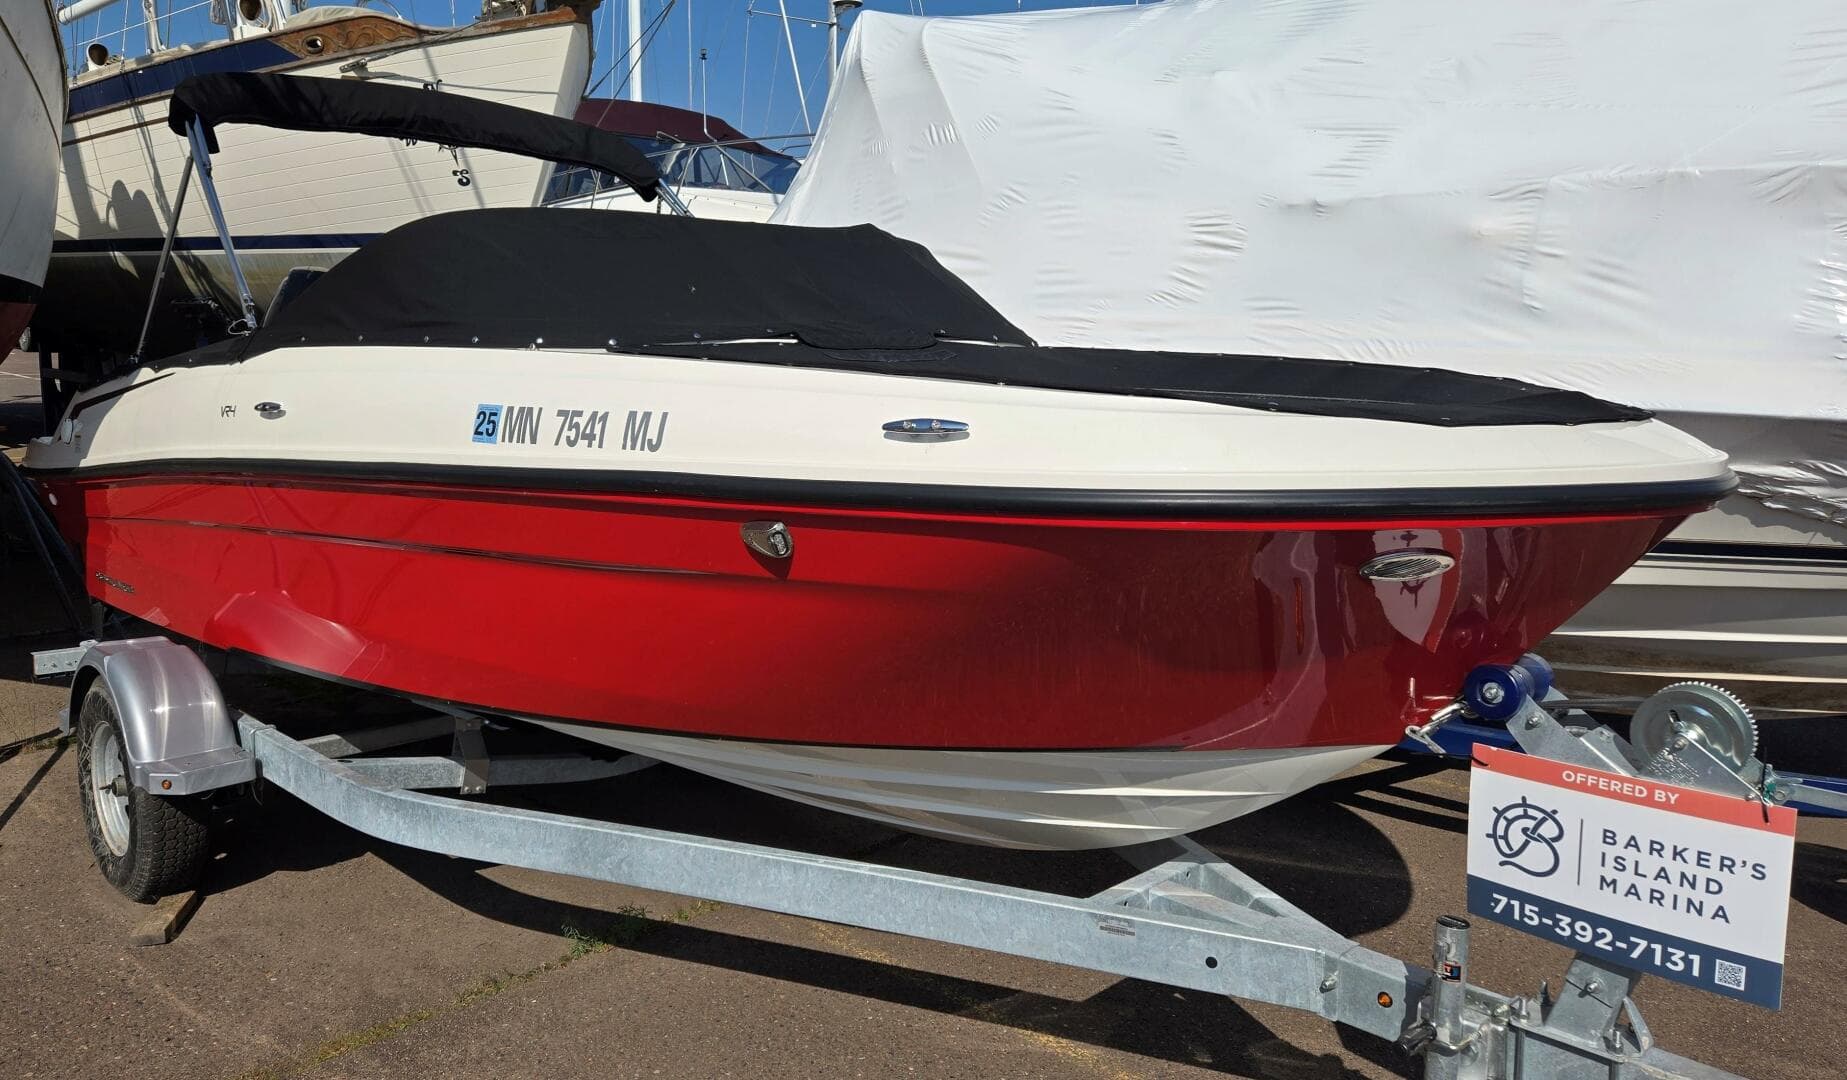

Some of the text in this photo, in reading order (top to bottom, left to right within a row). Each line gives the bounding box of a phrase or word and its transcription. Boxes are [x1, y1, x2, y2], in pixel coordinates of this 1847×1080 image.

[474, 410, 498, 437] 25
[501, 405, 669, 453] MN 7541 MJ
[1561, 770, 1680, 804] OFFERED BY
[1600, 851, 1723, 895] ISLAND
[1601, 828, 1767, 881] BARKER'S
[1599, 875, 1731, 925] MARINA
[1491, 893, 1701, 977] 715-392-7131
